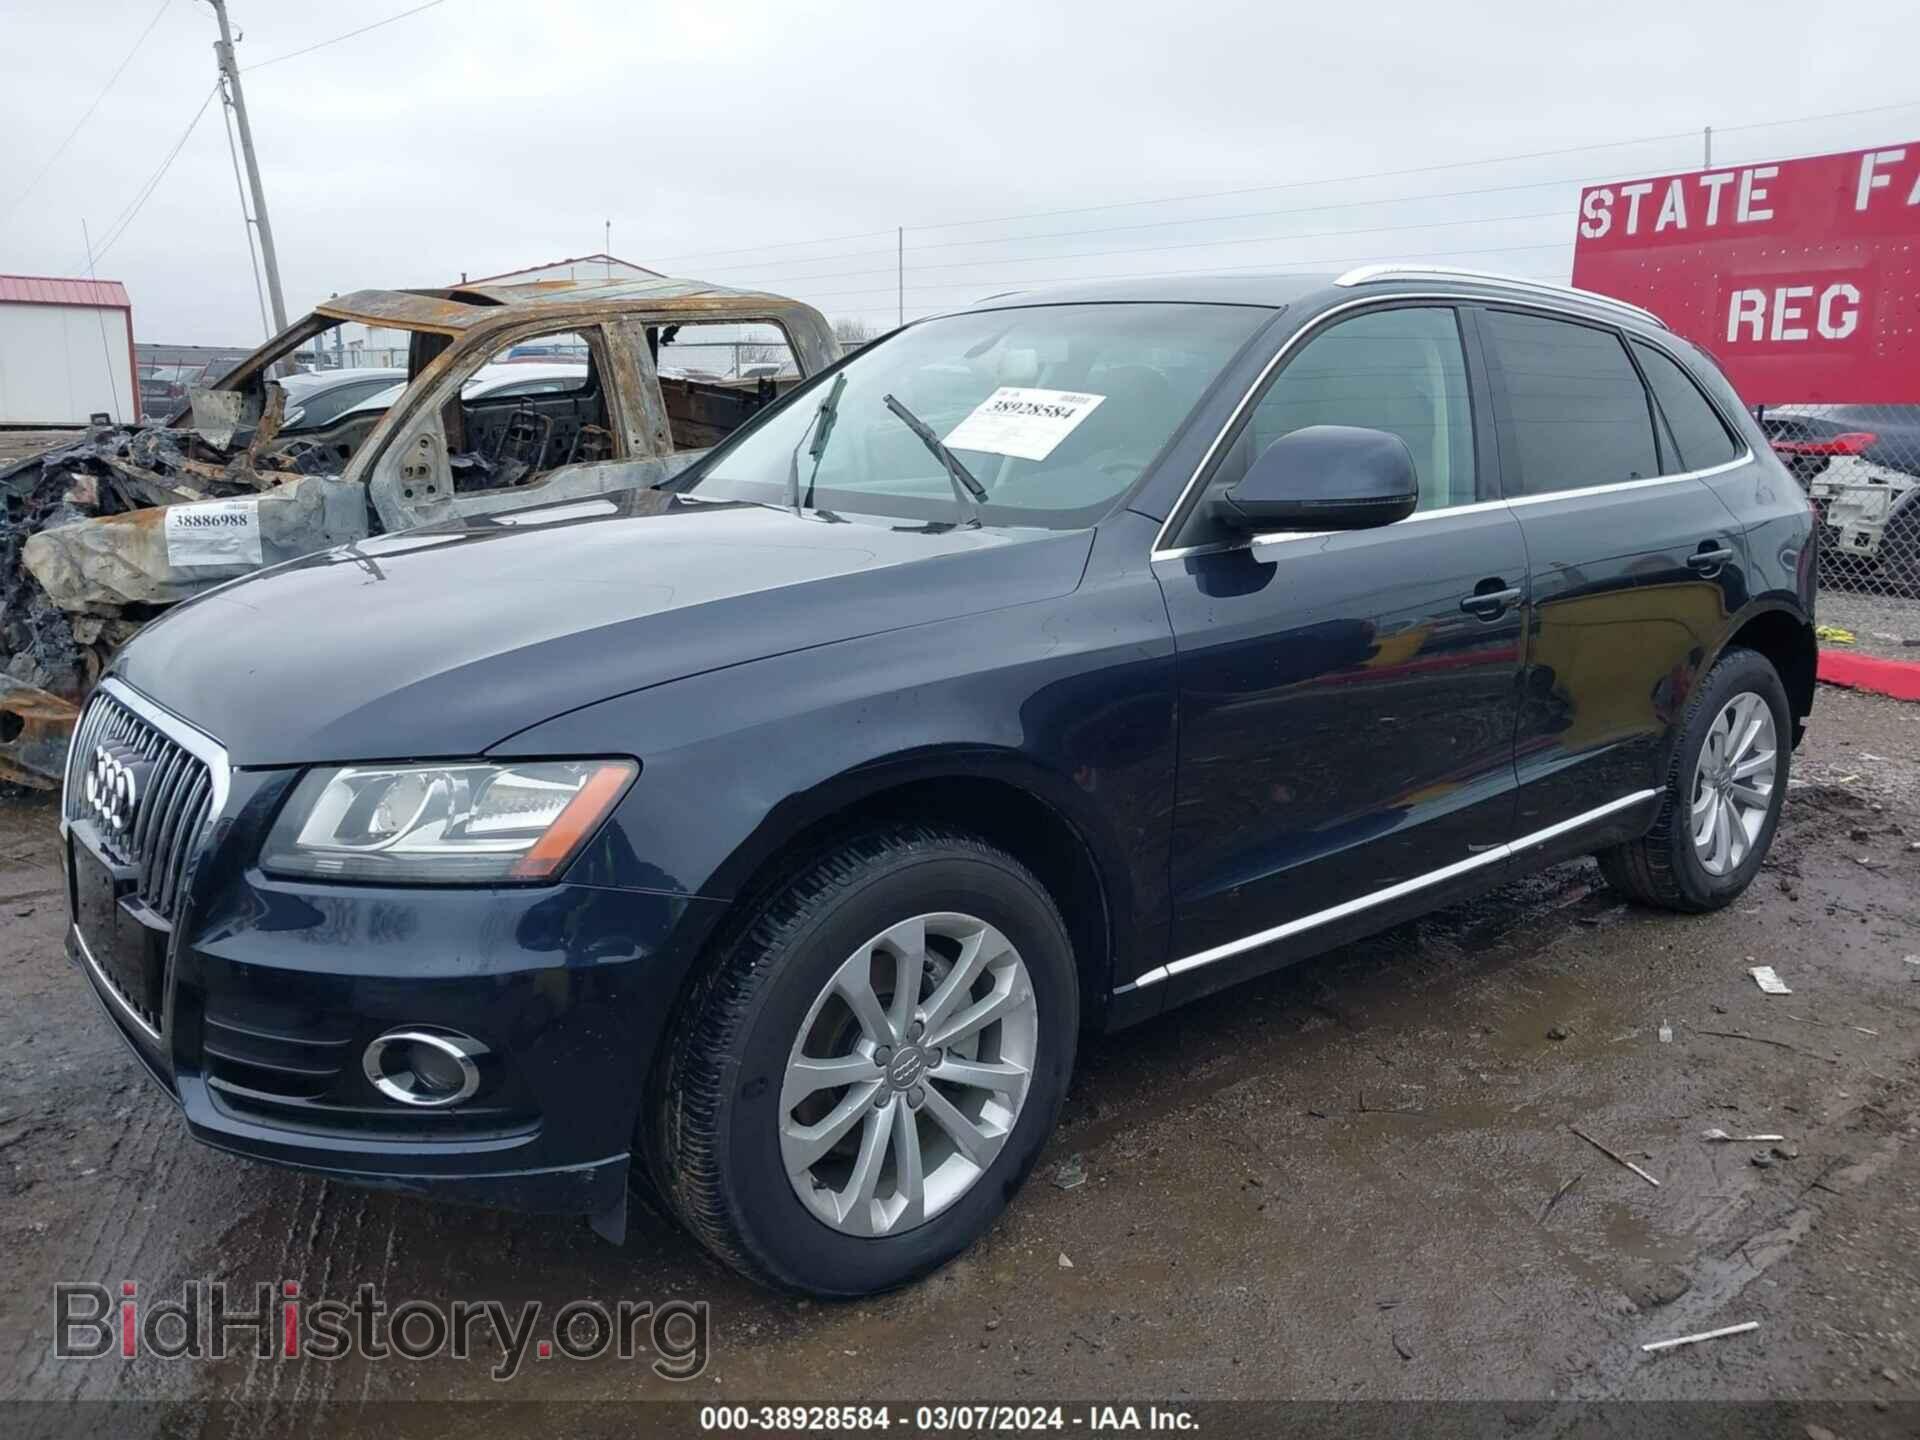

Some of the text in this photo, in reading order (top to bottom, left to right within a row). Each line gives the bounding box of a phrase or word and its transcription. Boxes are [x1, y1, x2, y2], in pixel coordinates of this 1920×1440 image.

[1580, 166, 1779, 238] STATE
[1726, 283, 1860, 343] REG
[986, 400, 1077, 420] 38928584
[175, 513, 248, 528] 38886988
